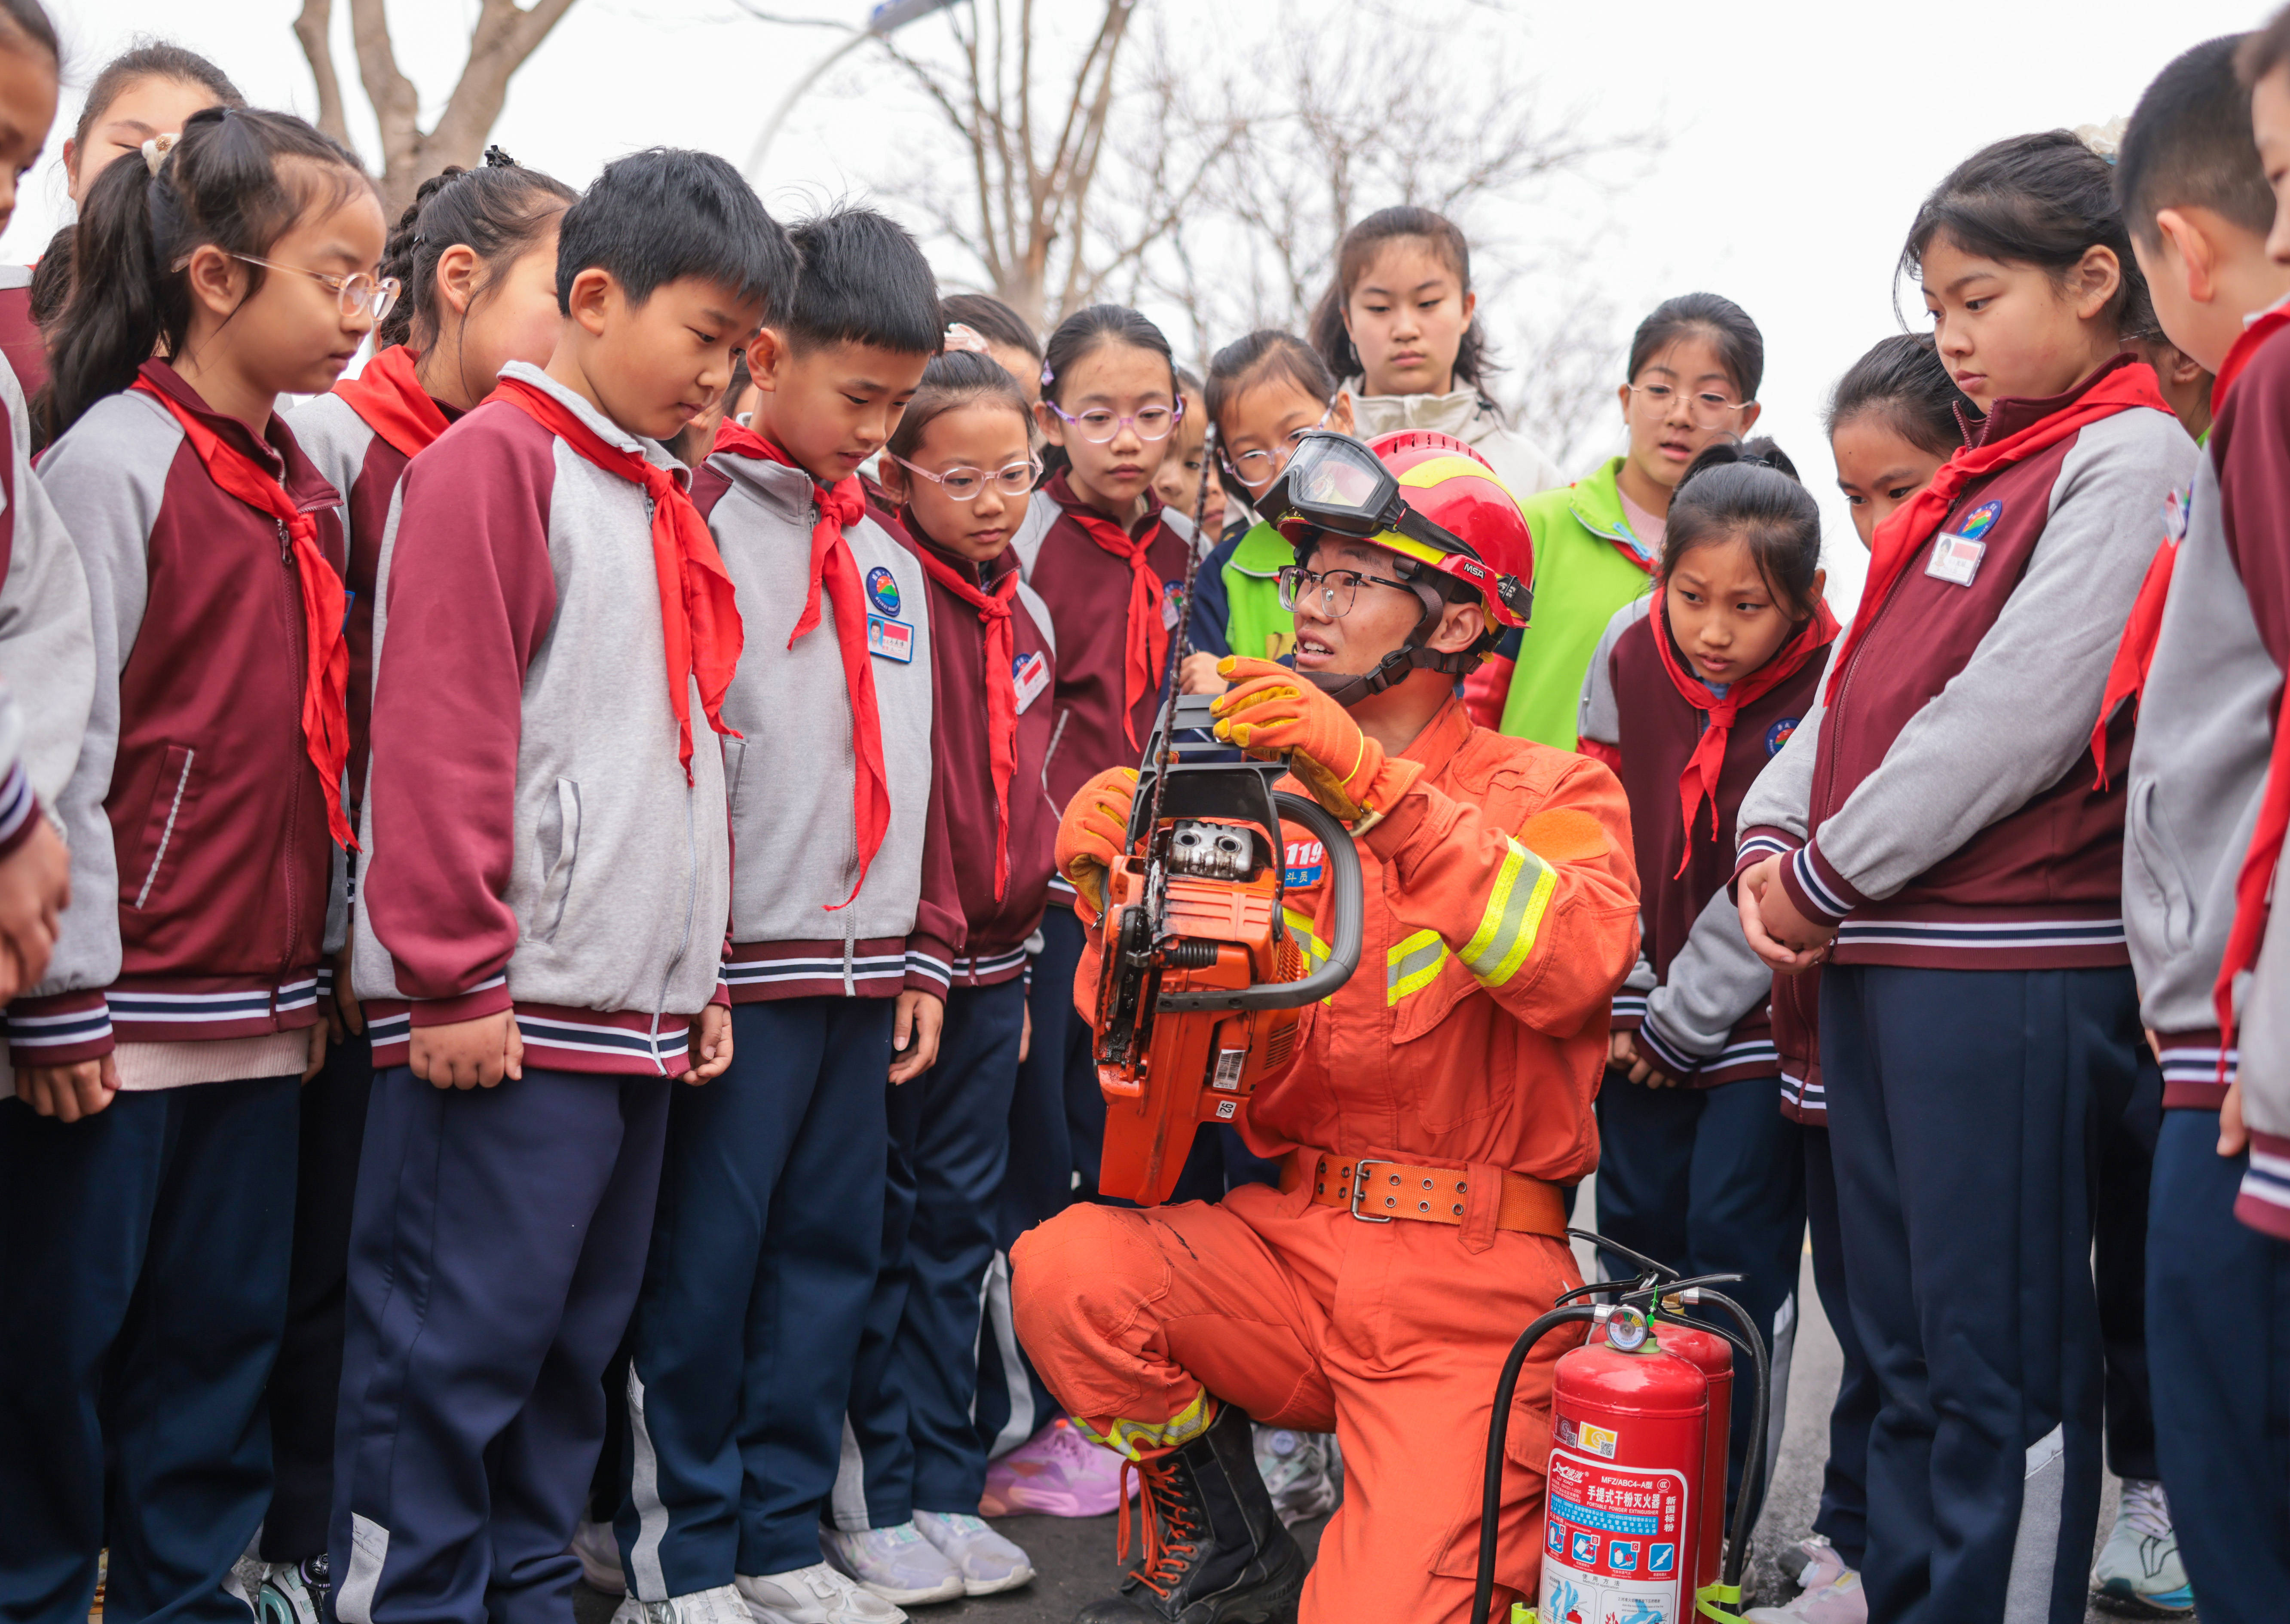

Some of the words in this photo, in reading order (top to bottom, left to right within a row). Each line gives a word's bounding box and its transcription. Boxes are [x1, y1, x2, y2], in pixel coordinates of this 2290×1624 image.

[1464, 563, 1484, 579] MSA
[1286, 841, 1323, 865] 119
[1219, 1103, 1234, 1113] 92
[1587, 1486, 1660, 1509] 手提式干粉灭火器
[1587, 1501, 1606, 1510] PORTABLE
[1664, 1496, 1676, 1532] 新国标粉
[1583, 1574, 1620, 1586] 使用方法
